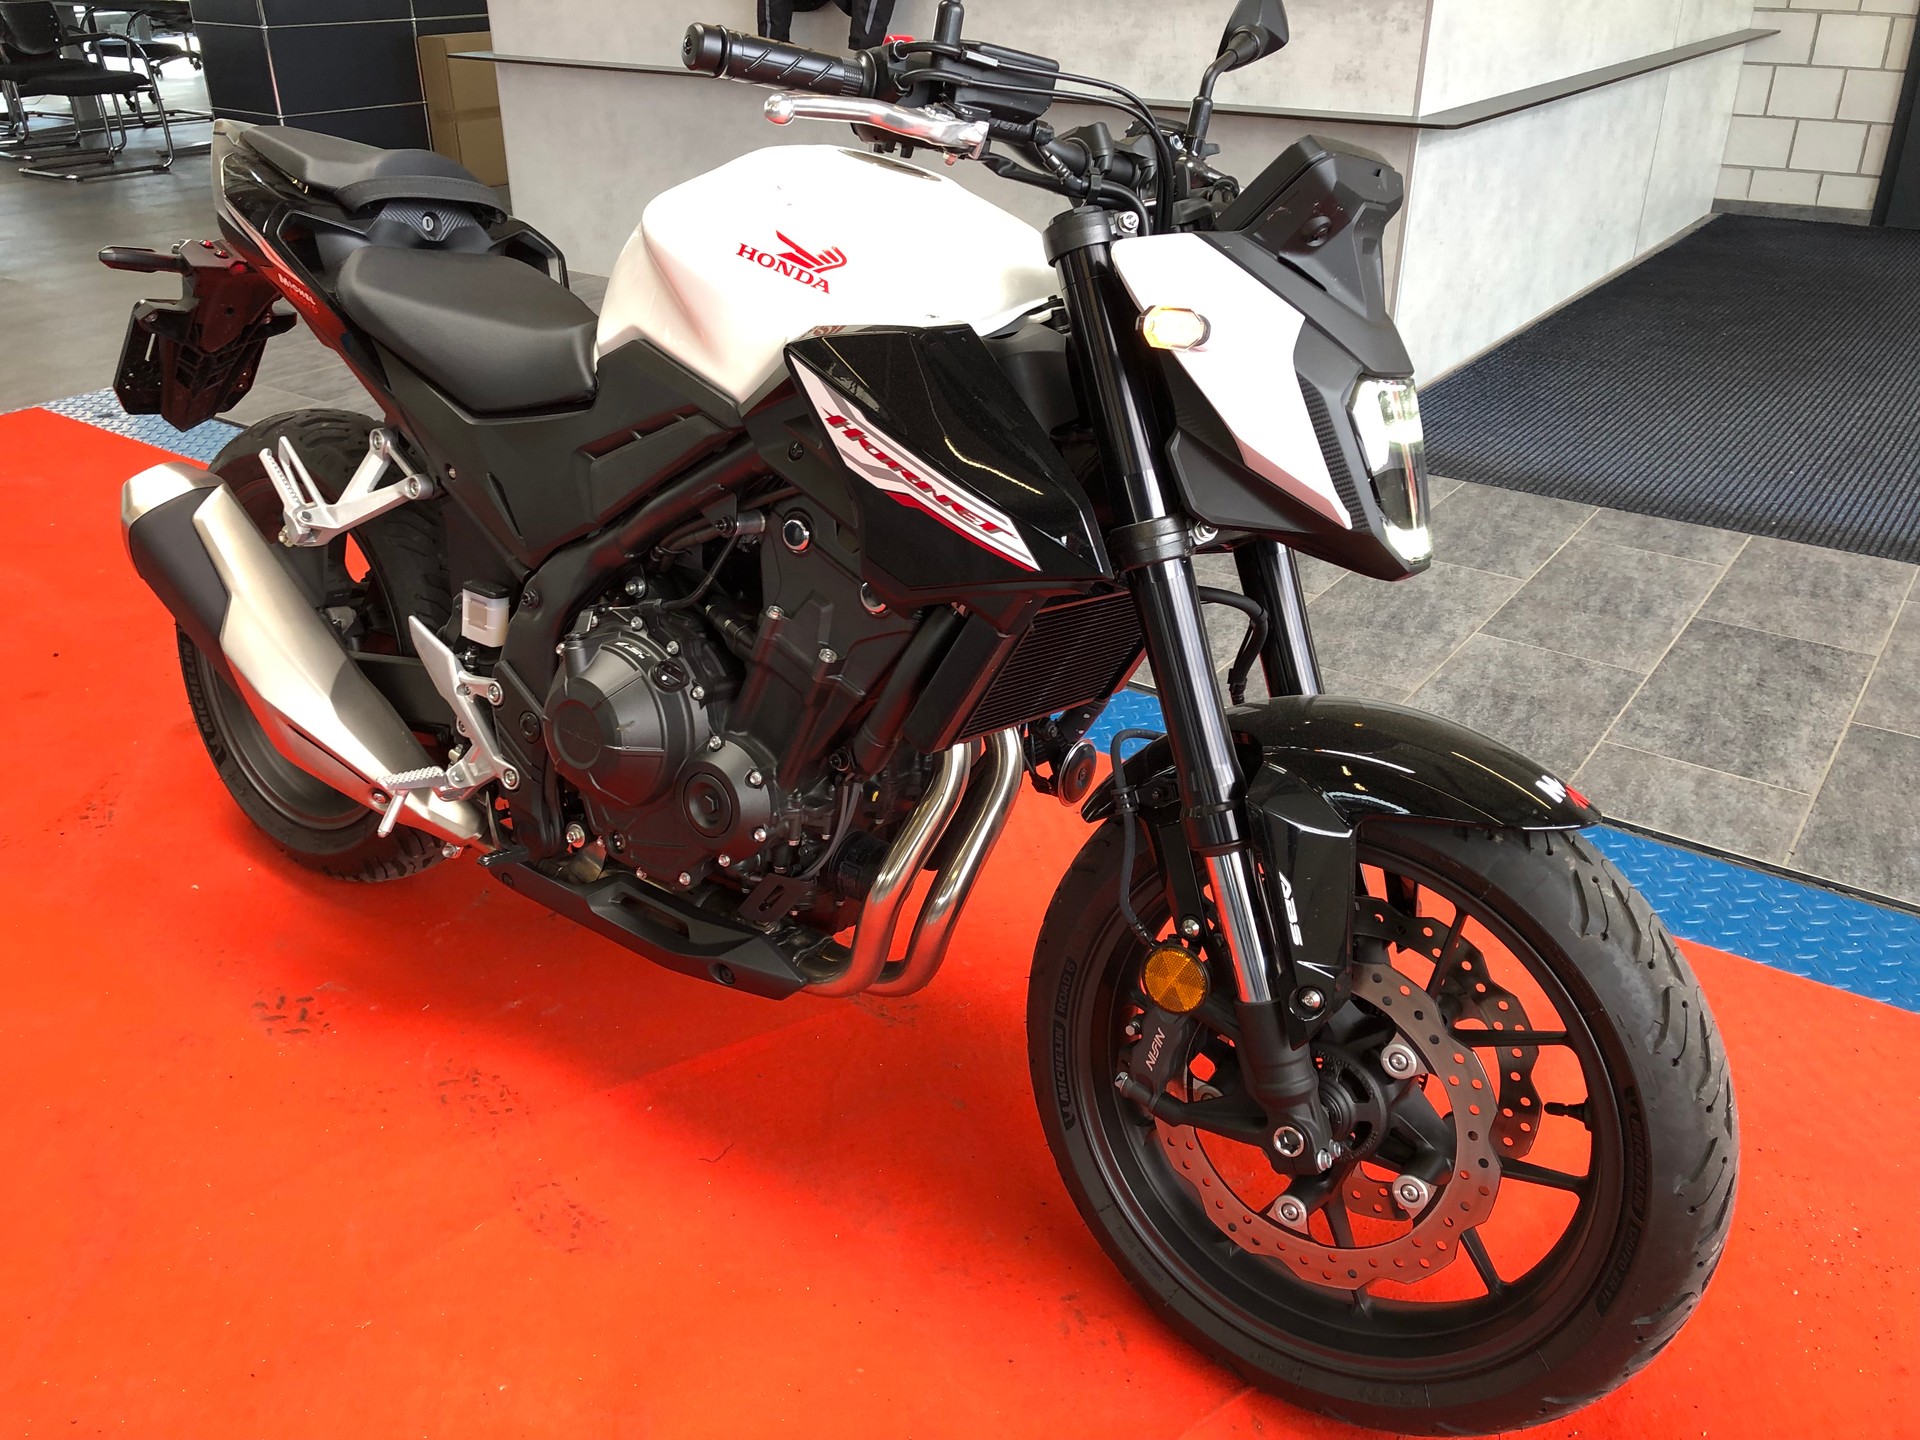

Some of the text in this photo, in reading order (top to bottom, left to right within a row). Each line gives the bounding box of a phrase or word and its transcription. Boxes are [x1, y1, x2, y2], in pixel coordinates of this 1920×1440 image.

[736, 242, 830, 294] HONDA
[821, 404, 1019, 541] HORNET
[182, 639, 214, 734] MICHELIN
[1278, 870, 1303, 947] ABS
[1056, 975, 1072, 1014] ROAD
[1054, 1026, 1072, 1103] MICHELIN
